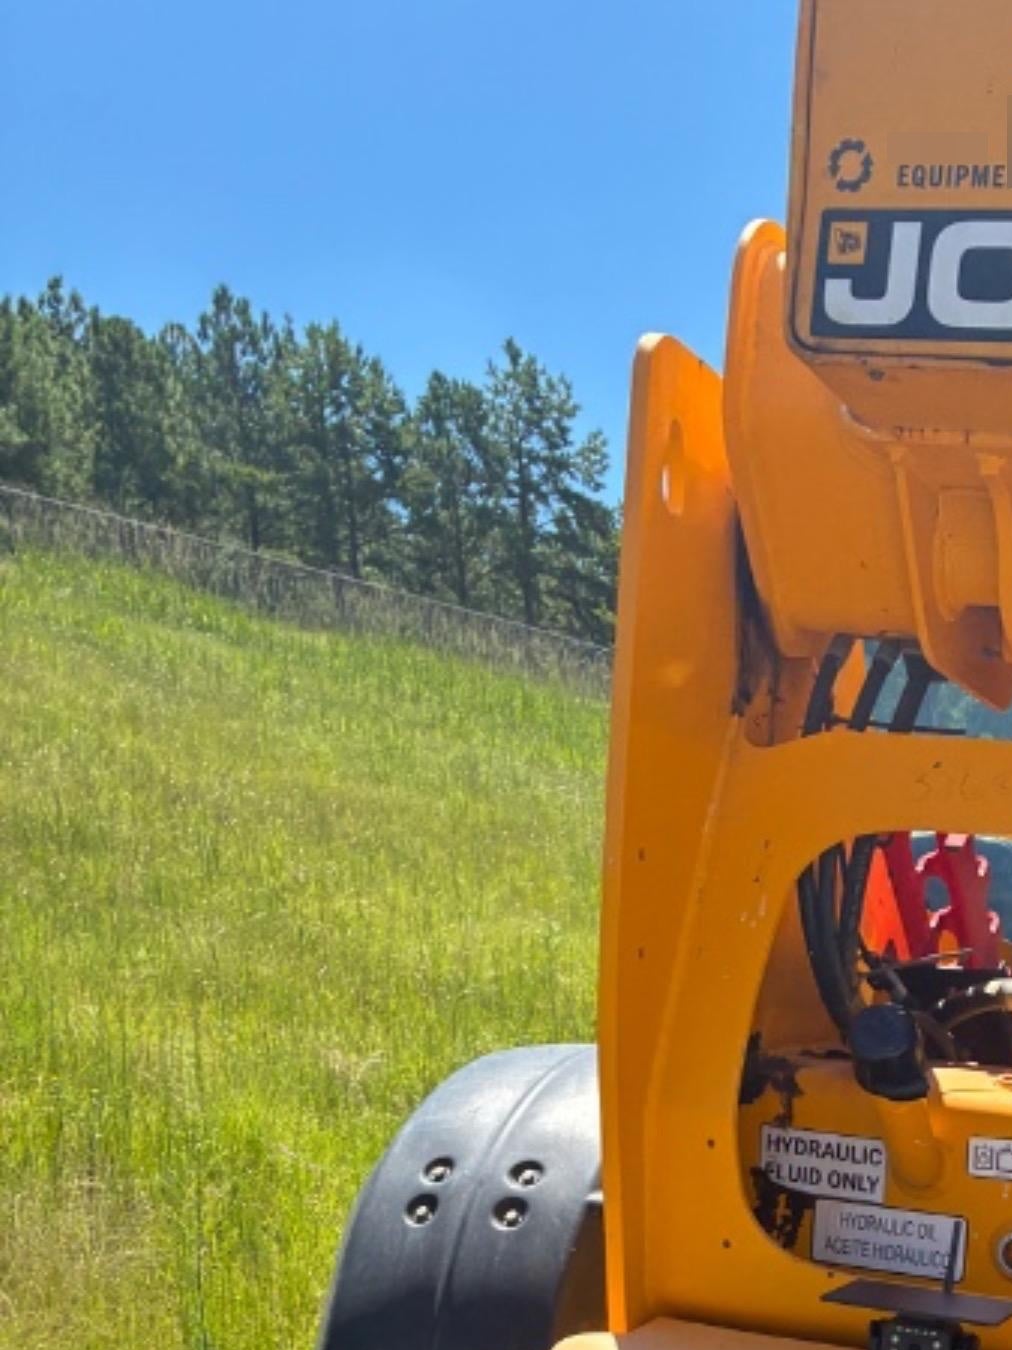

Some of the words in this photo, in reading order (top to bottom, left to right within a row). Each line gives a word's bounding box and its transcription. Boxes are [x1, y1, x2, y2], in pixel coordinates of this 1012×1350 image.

[897, 164, 1007, 188] EQUIPME
[766, 1133, 883, 1167] HYDRAULIC
[827, 1169, 880, 1194] ONLY
[840, 1211, 914, 1237] HYDRAULIC
[917, 1222, 937, 1242] OIL
